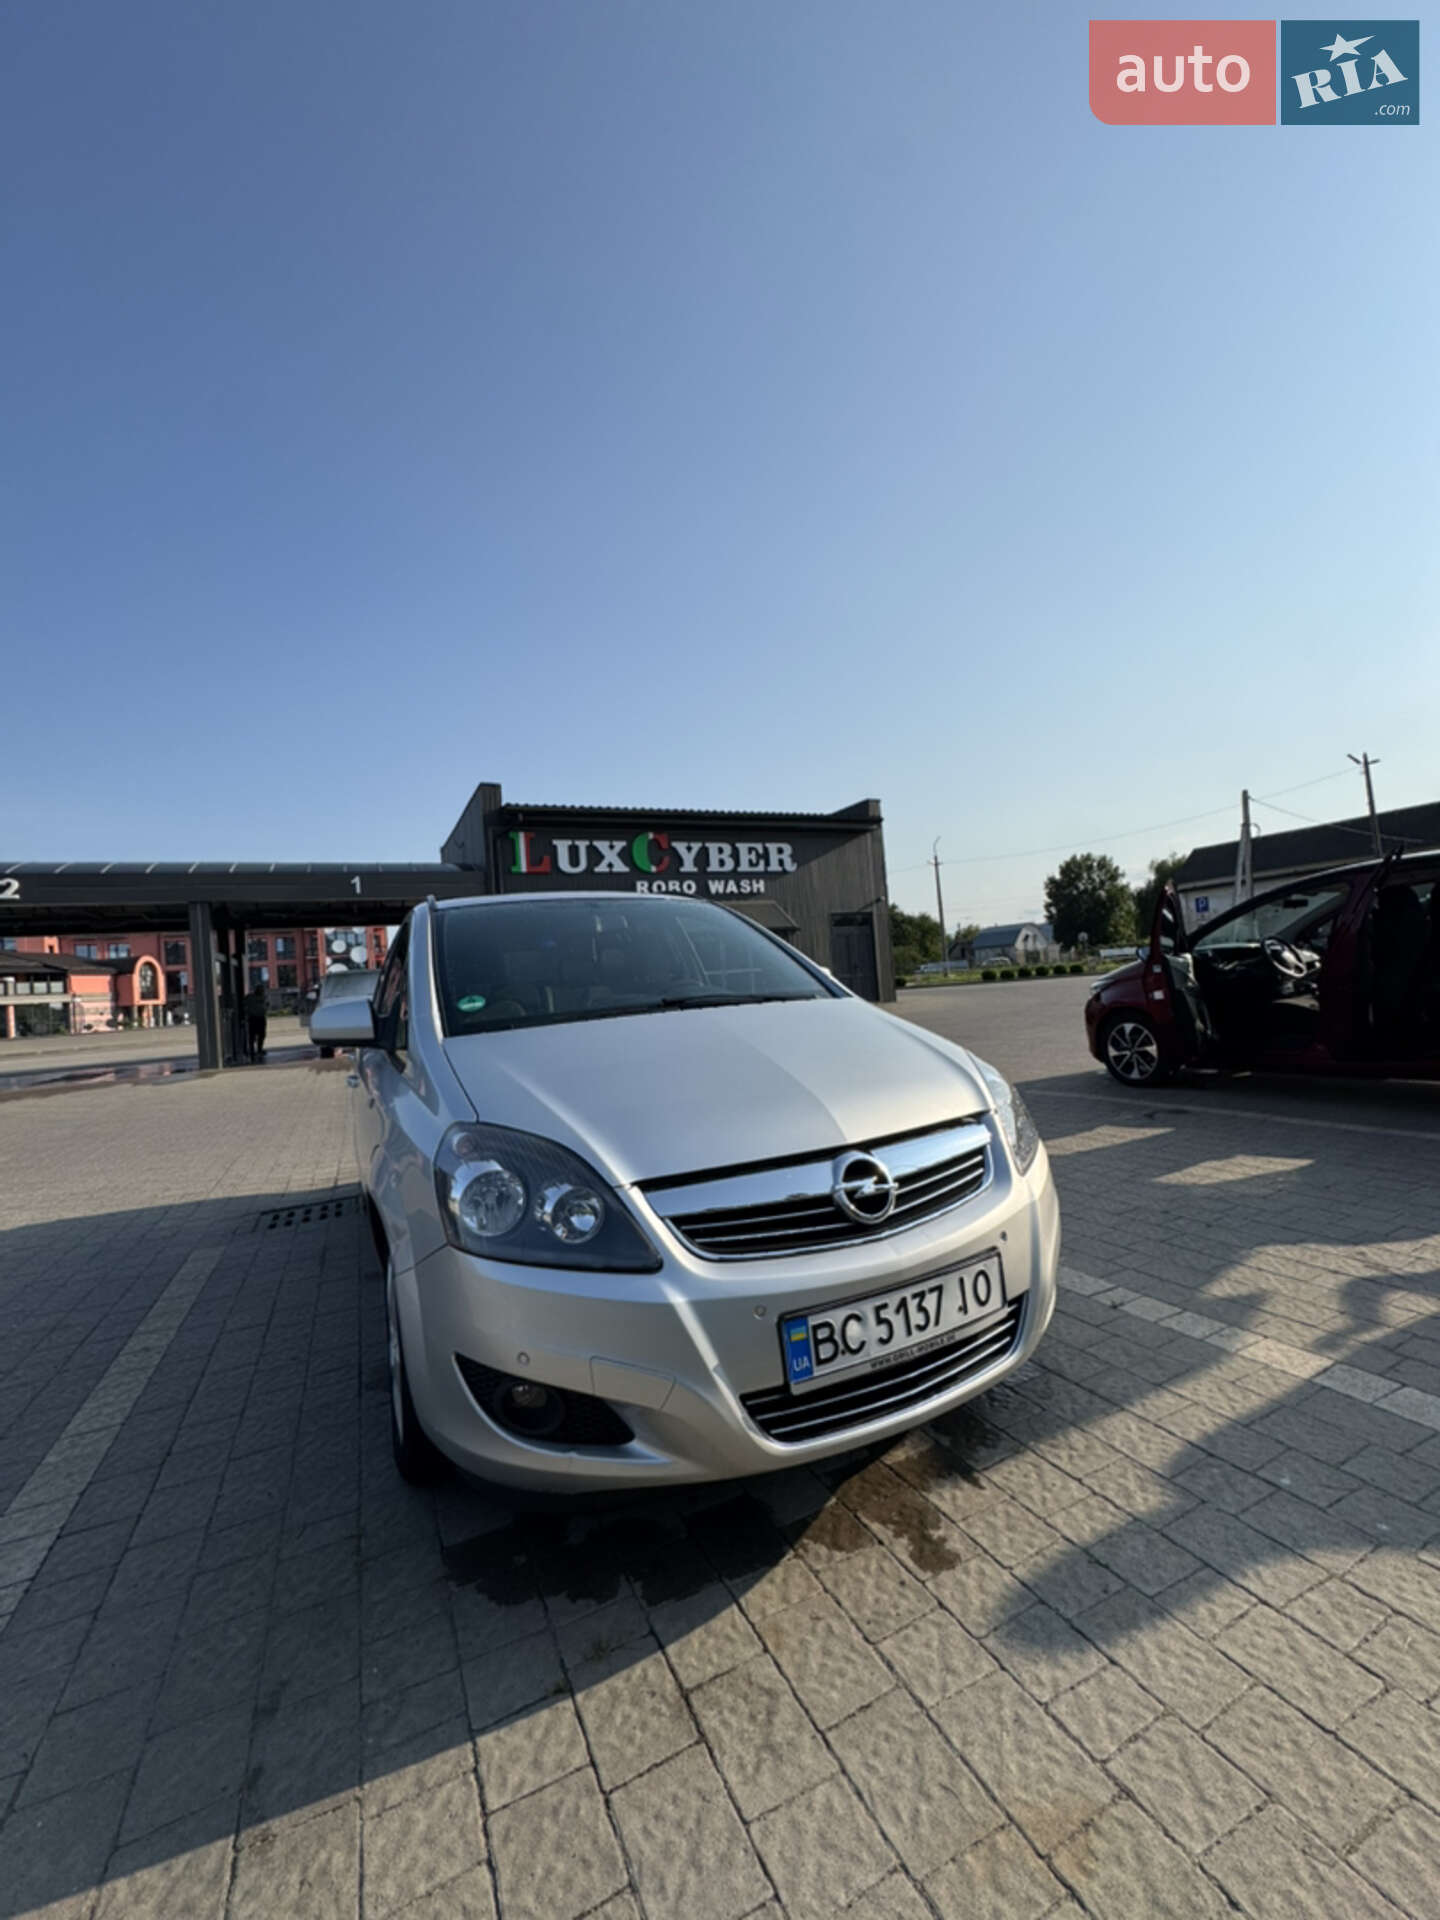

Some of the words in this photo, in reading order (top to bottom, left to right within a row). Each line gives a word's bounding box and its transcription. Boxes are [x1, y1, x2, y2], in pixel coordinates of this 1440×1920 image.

[0, 878, 20, 899] 2
[350, 876, 362, 894] 1
[636, 880, 697, 895] ROBO
[707, 878, 765, 894] WASH
[811, 1312, 866, 1367] BC
[874, 1284, 944, 1346] 5137
[793, 1357, 811, 1372] UA
